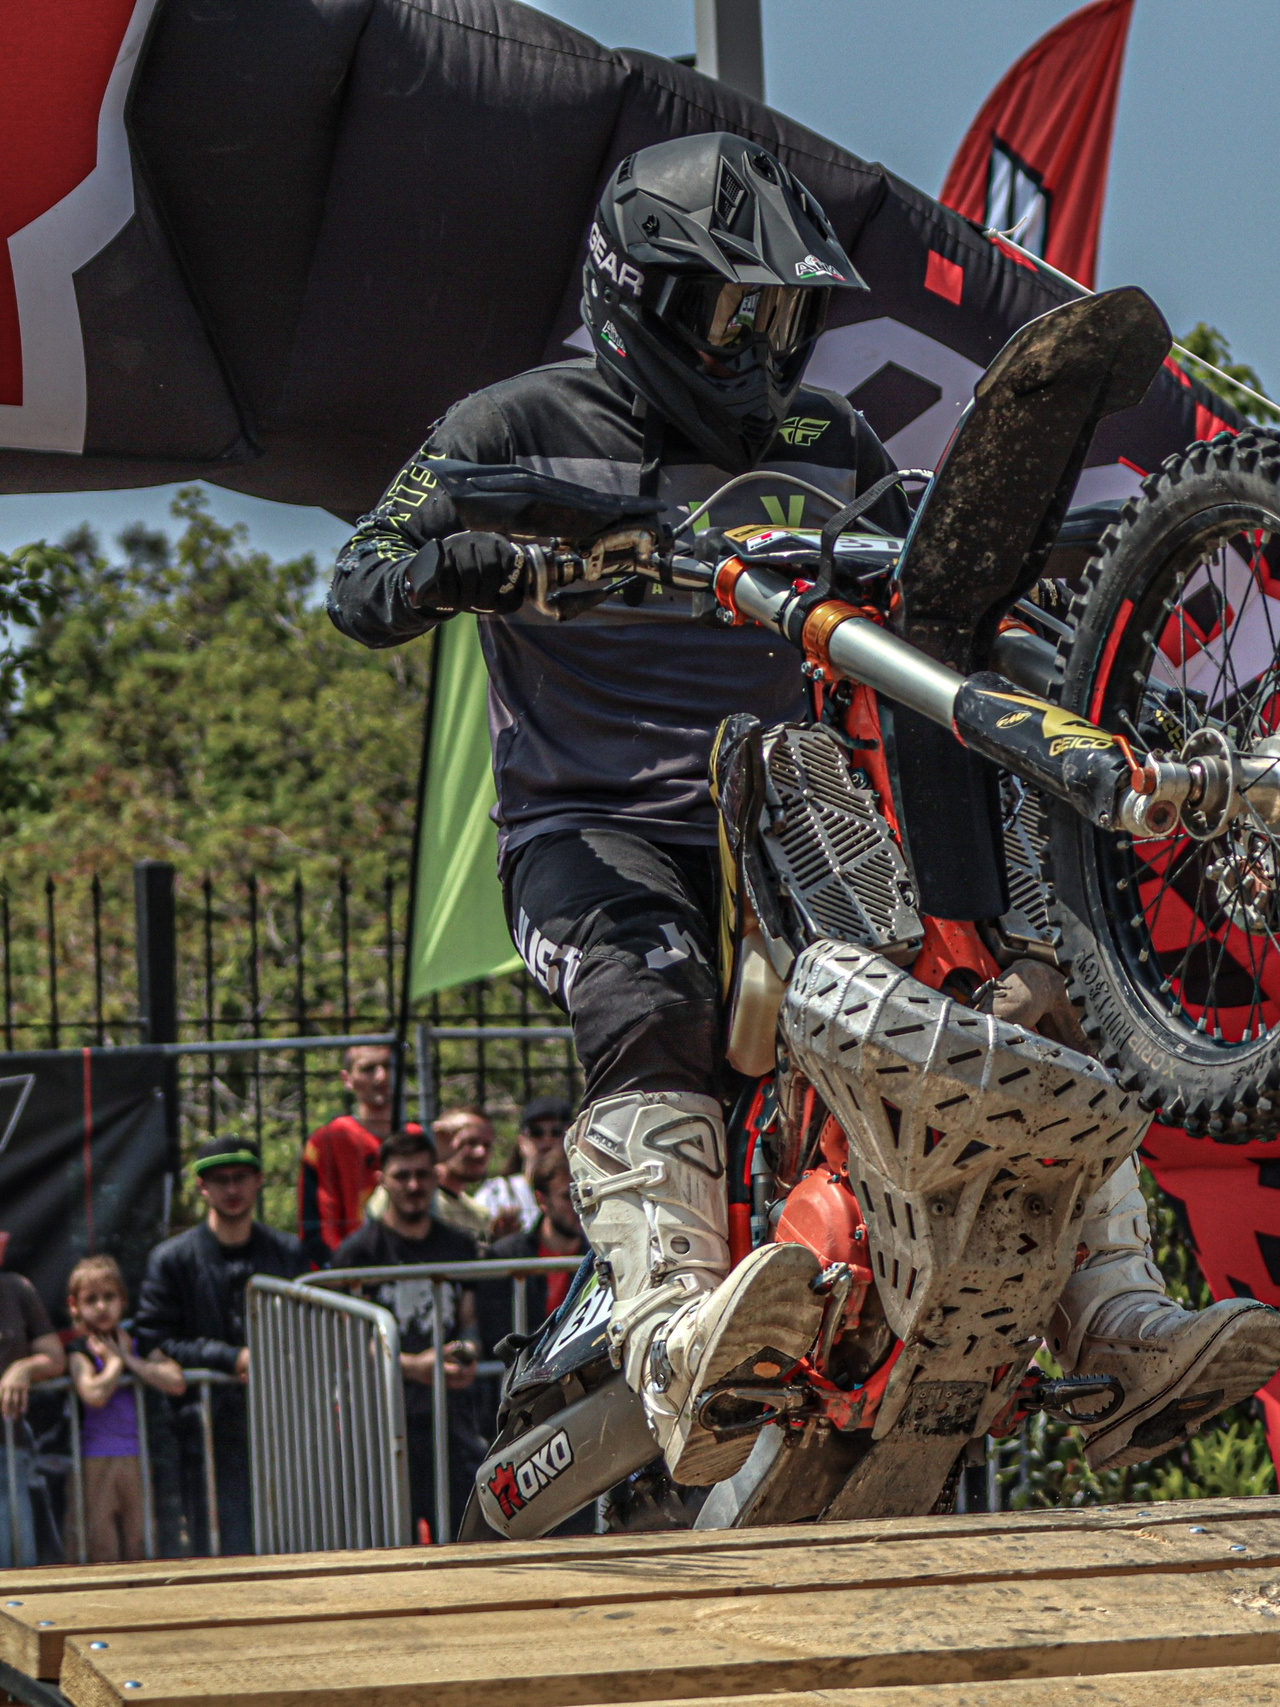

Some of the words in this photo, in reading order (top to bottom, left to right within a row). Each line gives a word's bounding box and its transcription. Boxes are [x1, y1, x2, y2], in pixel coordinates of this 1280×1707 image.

[589, 221, 646, 297] GEAR
[1048, 736, 1115, 757] GEICO
[487, 1426, 575, 1521] ROKO
